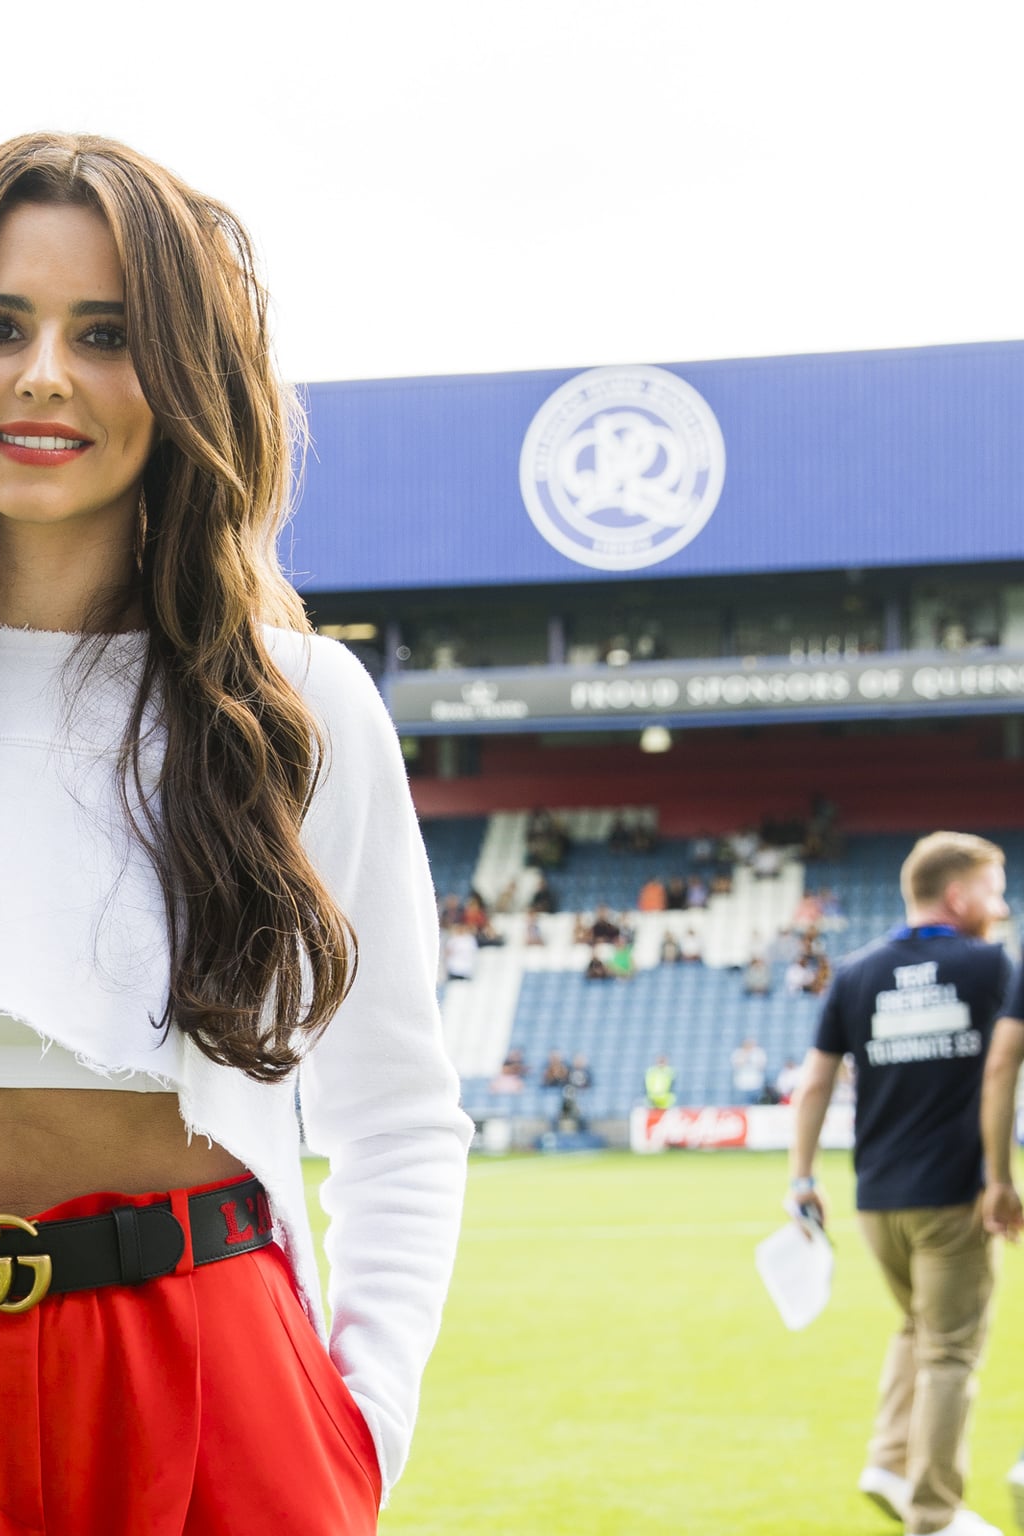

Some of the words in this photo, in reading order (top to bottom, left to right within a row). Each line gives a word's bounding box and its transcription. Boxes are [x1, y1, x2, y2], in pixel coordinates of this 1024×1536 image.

[571, 679, 679, 709] PROUD
[687, 670, 850, 706] SPONSORS
[858, 668, 903, 700] OF
[912, 664, 1024, 701] QUEEN
